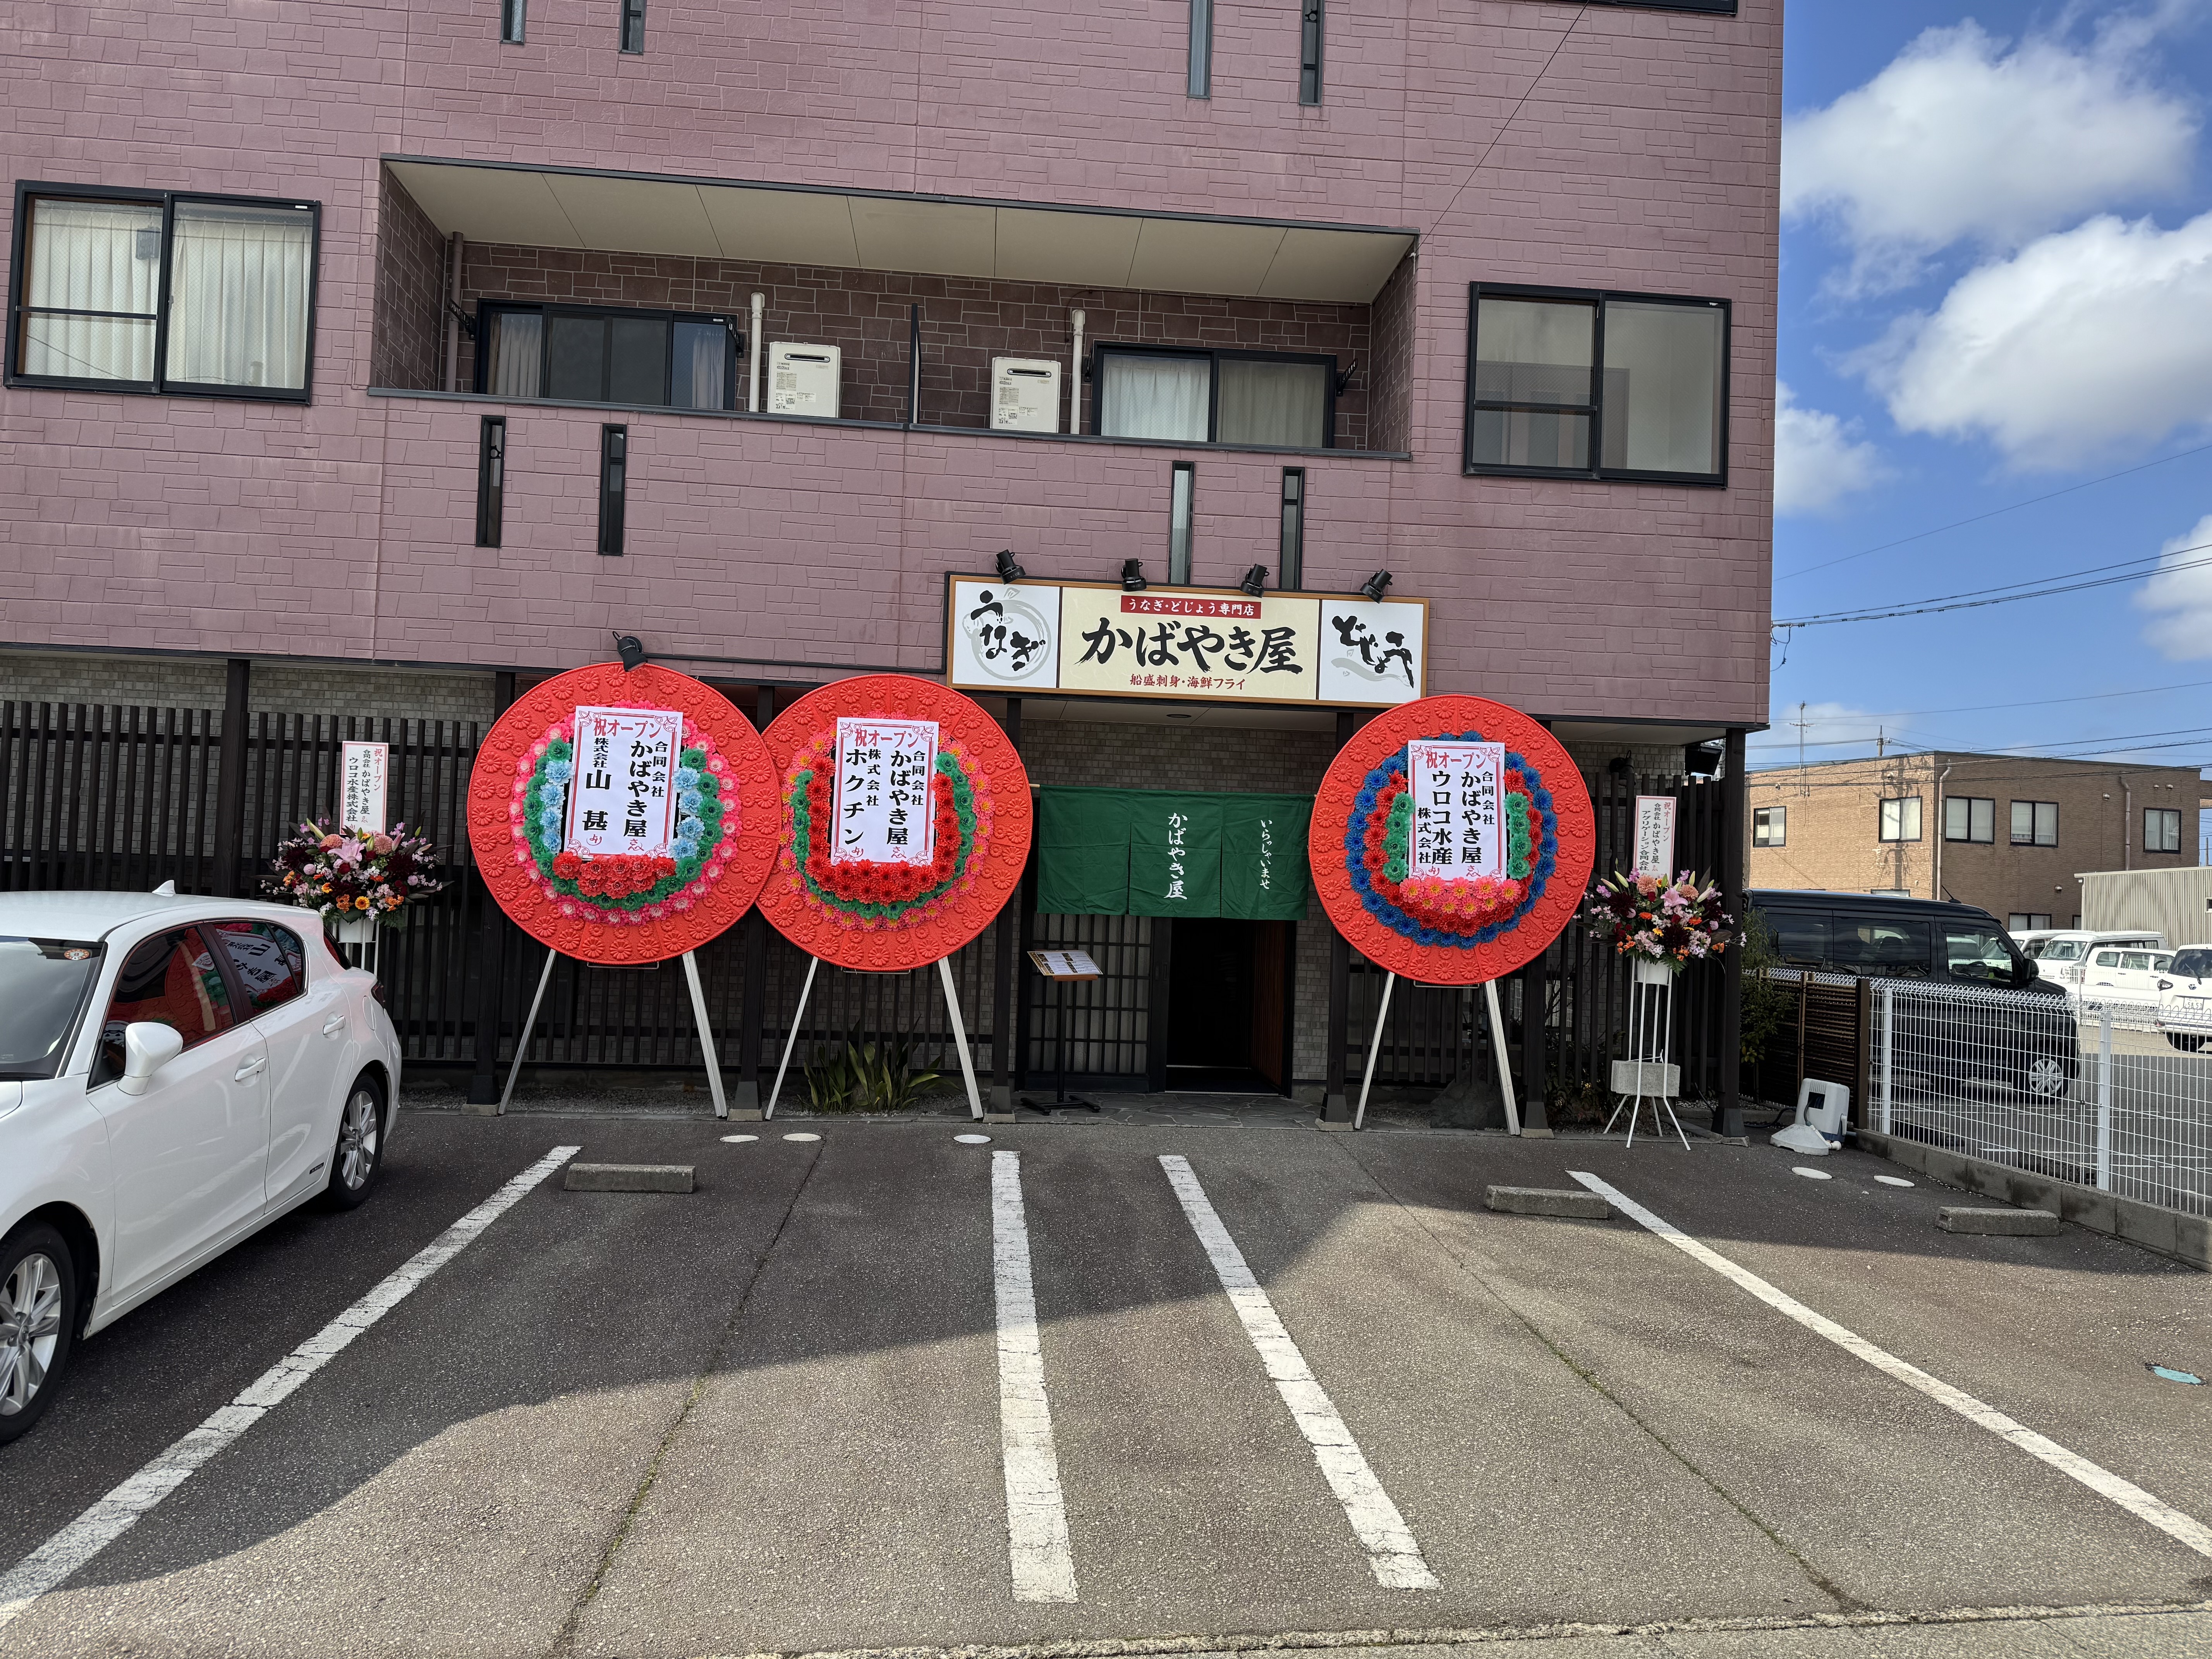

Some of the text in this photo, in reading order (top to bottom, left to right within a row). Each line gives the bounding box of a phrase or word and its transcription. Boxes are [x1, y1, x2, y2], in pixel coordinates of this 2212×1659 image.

[971, 590, 1046, 671] うなぎ
[1129, 599, 1255, 616] うなぎ・どじょう専門店
[1074, 617, 1303, 675] かばやき屋
[1130, 674, 1245, 690] 船盛刺身・海鮮フライ
[592, 738, 609, 768] 株式会社
[594, 718, 661, 738] 祝オープン
[855, 729, 919, 748] 祝オープン
[374, 748, 383, 791] 祝オープン
[651, 741, 668, 797] 合同会社
[866, 749, 881, 806] 株式会社
[911, 750, 926, 805] 合同会社
[1425, 752, 1487, 769] 祝オープン
[360, 770, 371, 815] かばやき屋
[623, 740, 653, 837] かばやき屋
[843, 749, 867, 845] ホクチン
[887, 750, 912, 845] かばやき屋
[1482, 771, 1495, 825] 合同会社
[1418, 807, 1432, 864] 株式会社
[1432, 771, 1453, 865] ウロコ水産
[1461, 771, 1482, 864] かばやき屋
[1651, 822, 1661, 864] かばやき屋
[1663, 802, 1671, 842] 祝オープン
[1163, 812, 1188, 900] かばやき屋
[1260, 820, 1273, 890] いらっしゃいませ
